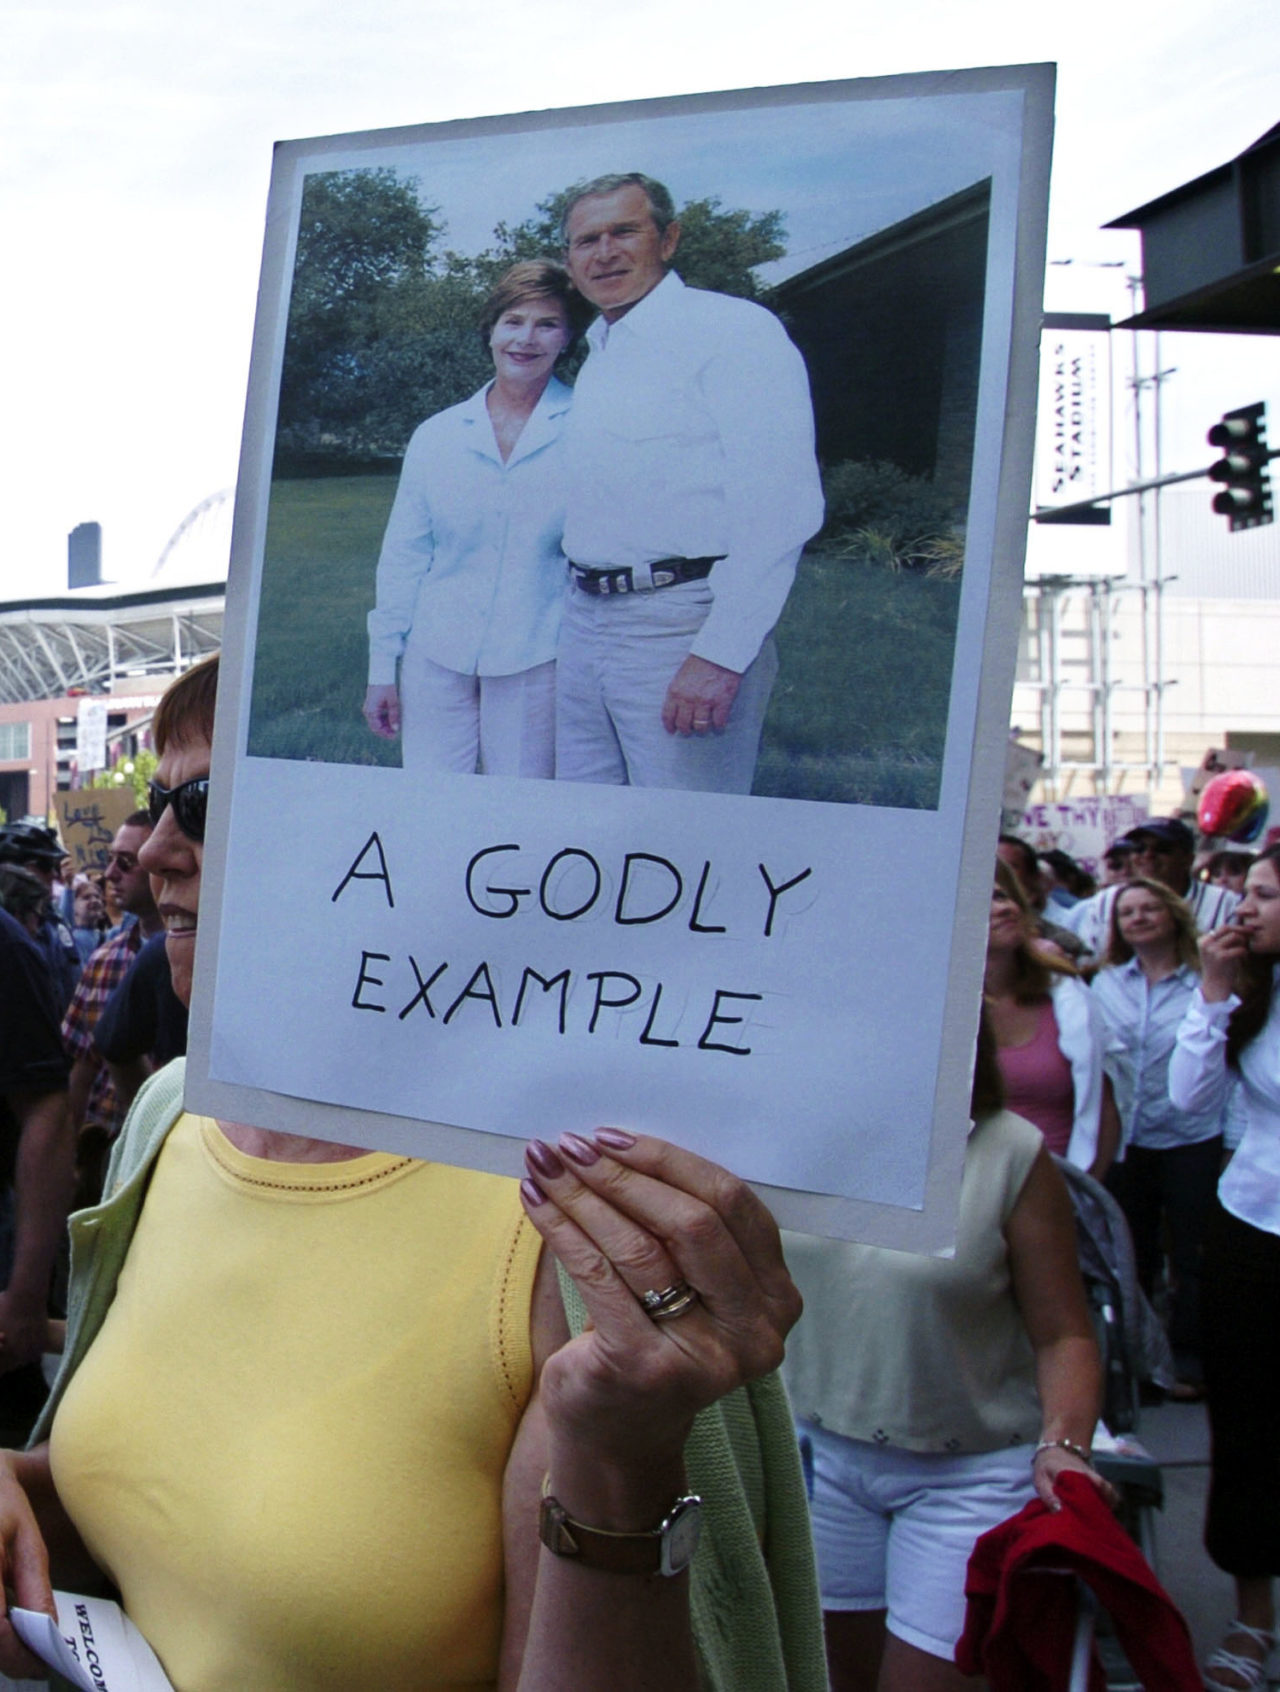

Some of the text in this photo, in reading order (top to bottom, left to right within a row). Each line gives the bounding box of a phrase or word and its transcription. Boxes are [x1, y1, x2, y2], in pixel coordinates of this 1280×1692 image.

[1052, 344, 1065, 493] SEAHAWKS
[1070, 357, 1082, 481] STADIUM
[331, 831, 813, 937] A GODLY
[351, 951, 764, 1056] EXAMPLE
